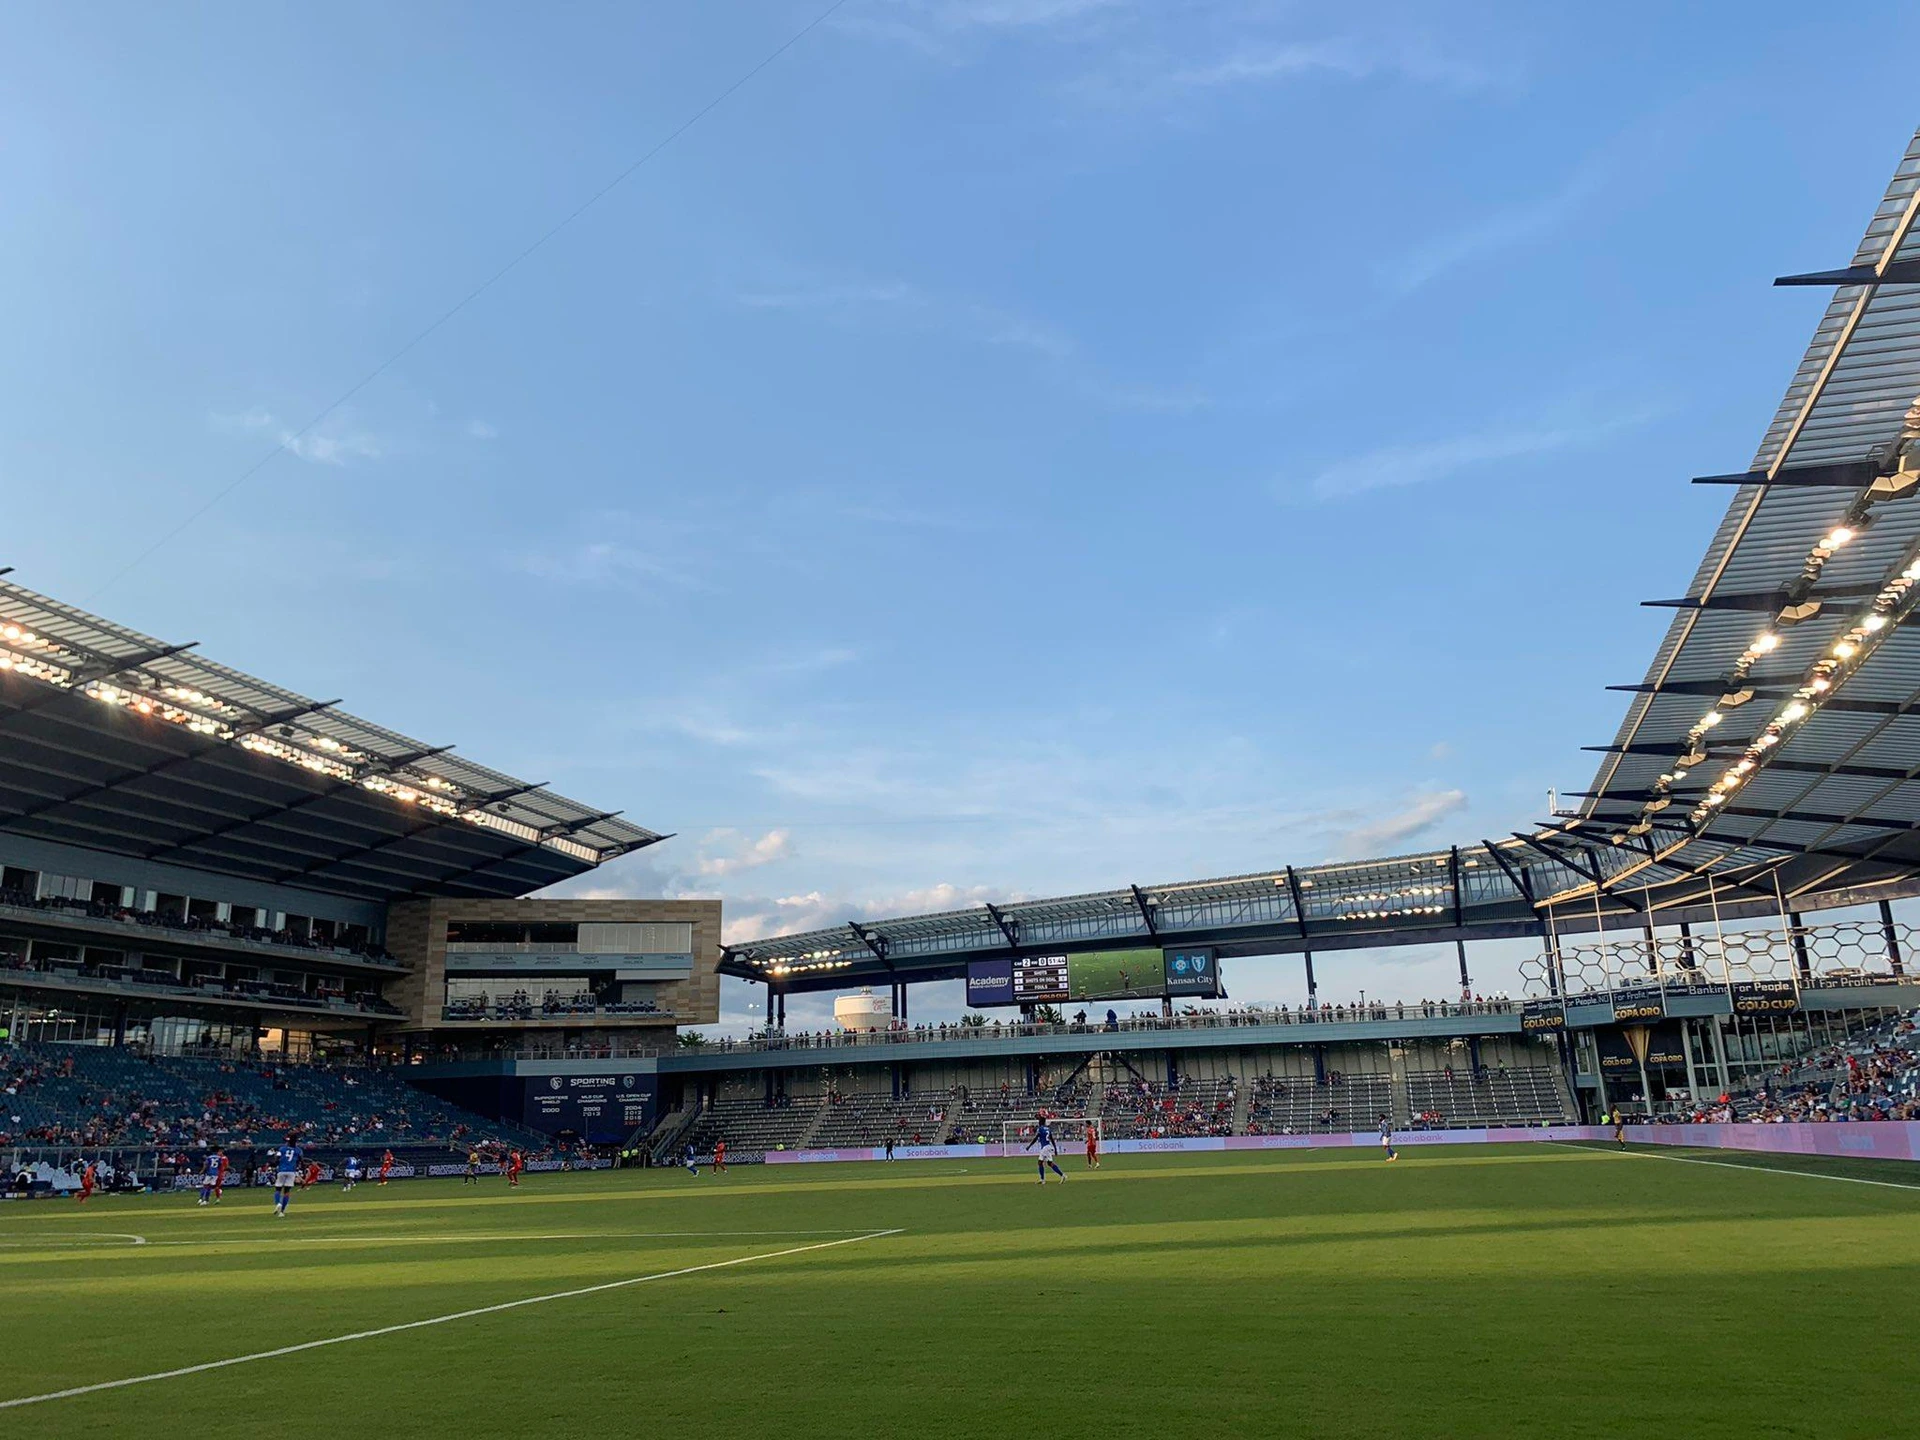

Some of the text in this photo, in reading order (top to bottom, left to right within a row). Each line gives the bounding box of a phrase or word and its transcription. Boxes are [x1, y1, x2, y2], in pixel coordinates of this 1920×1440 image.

[1048, 957, 1065, 965] 51:44
[969, 976, 1010, 986] Academy
[1167, 975, 1214, 985] Kansas City
[1733, 983, 1751, 993] For
[1754, 981, 1792, 992] People.
[1820, 979, 1838, 989] For
[1538, 1001, 1562, 1010] Banking
[1613, 993, 1626, 1001] For
[1736, 999, 1795, 1010] GOLD CUP
[1614, 1006, 1660, 1019] COPA ORO
[1523, 1016, 1563, 1028] GOLD CUP
[1650, 1054, 1683, 1063] COPA ORO
[570, 1077, 616, 1087] SPORTING
[1045, 1130, 1050, 1141] 2
[1392, 1133, 1444, 1143] Scotiabank
[1138, 1141, 1185, 1150] Scotiabank
[285, 1149, 295, 1162] 4
[797, 1151, 838, 1161] Scotiabank
[906, 1148, 949, 1157] Scotiabank
